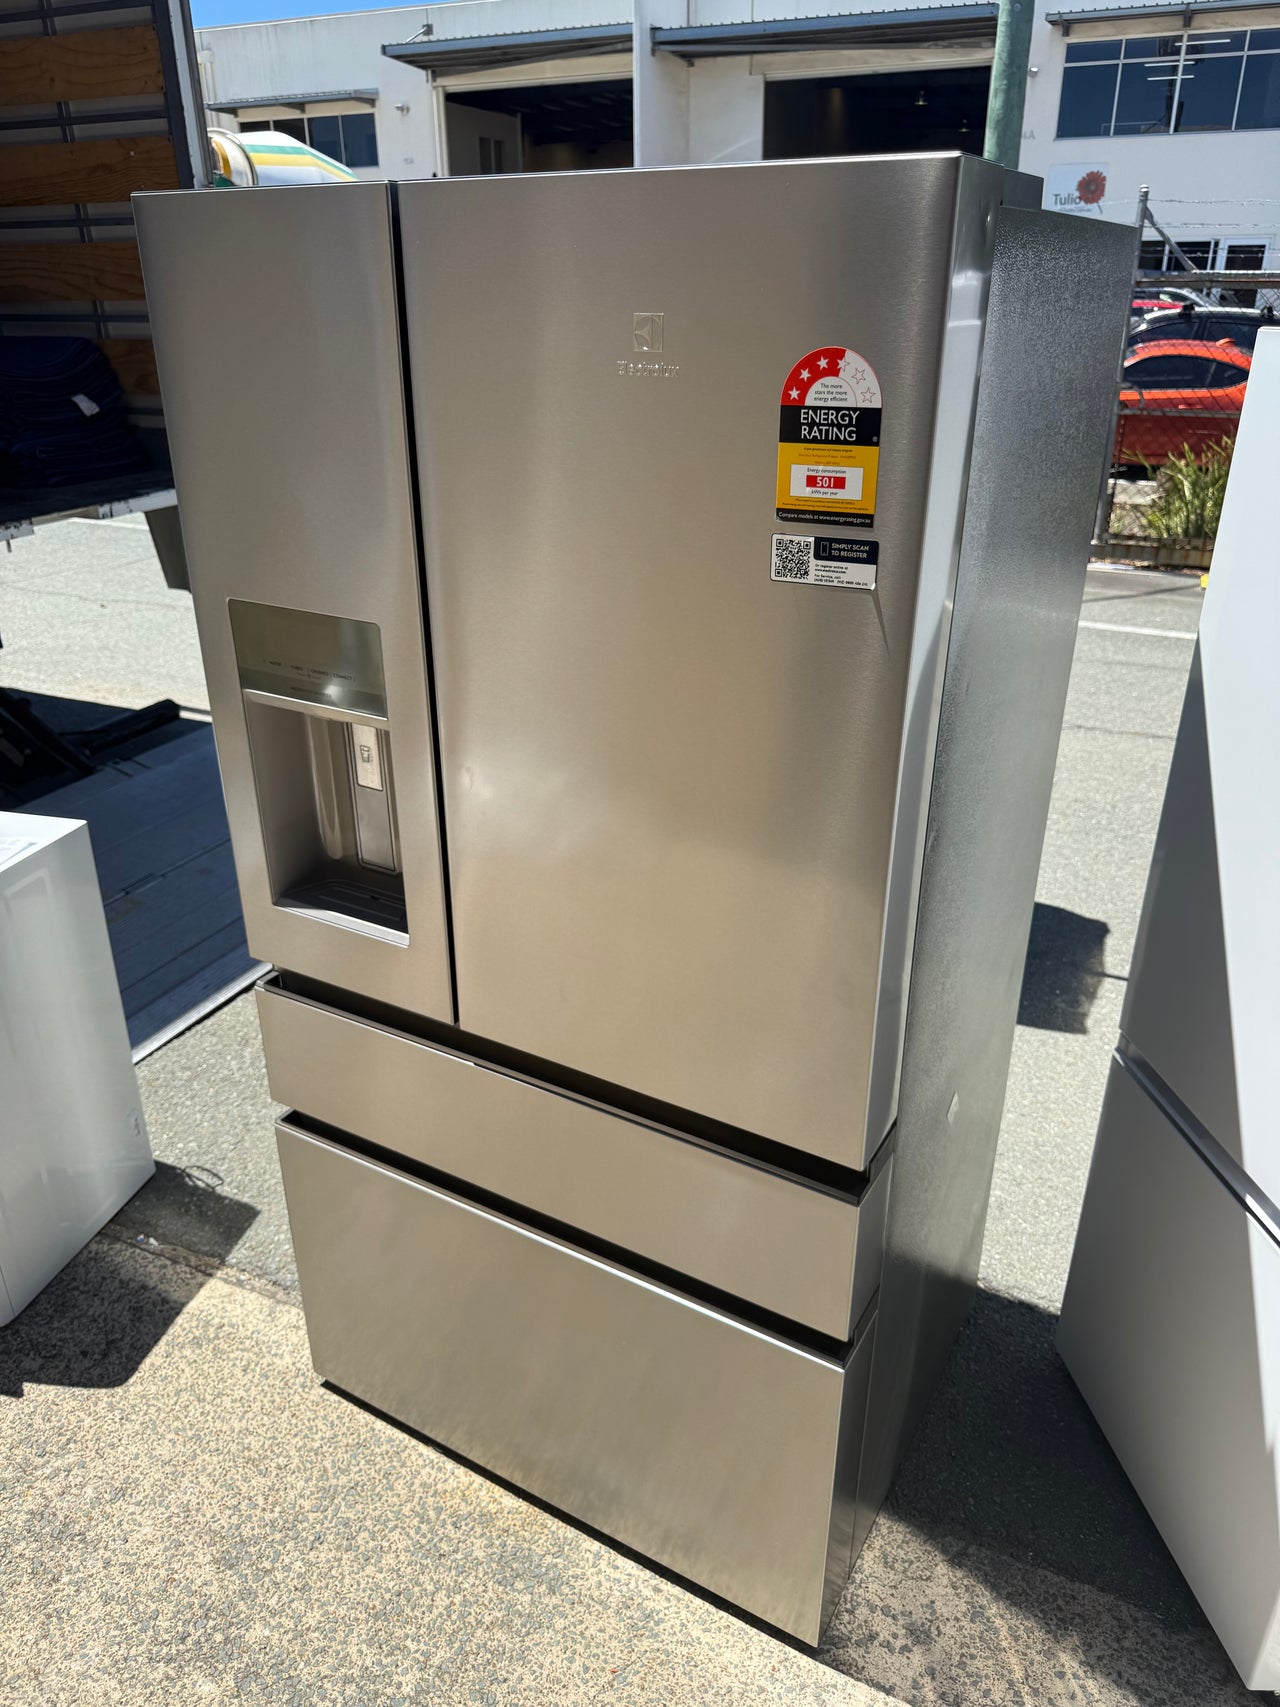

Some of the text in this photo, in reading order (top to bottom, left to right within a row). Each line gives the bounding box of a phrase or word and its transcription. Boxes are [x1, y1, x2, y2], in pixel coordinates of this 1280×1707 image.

[1053, 193, 1081, 206] Tulio
[800, 409, 860, 425] ENERGY
[801, 426, 857, 441] RATING
[816, 477, 834, 488] 501
[778, 511, 798, 519] Compare
[831, 542, 852, 551] SIMPLY
[840, 551, 868, 559] REGISTER
